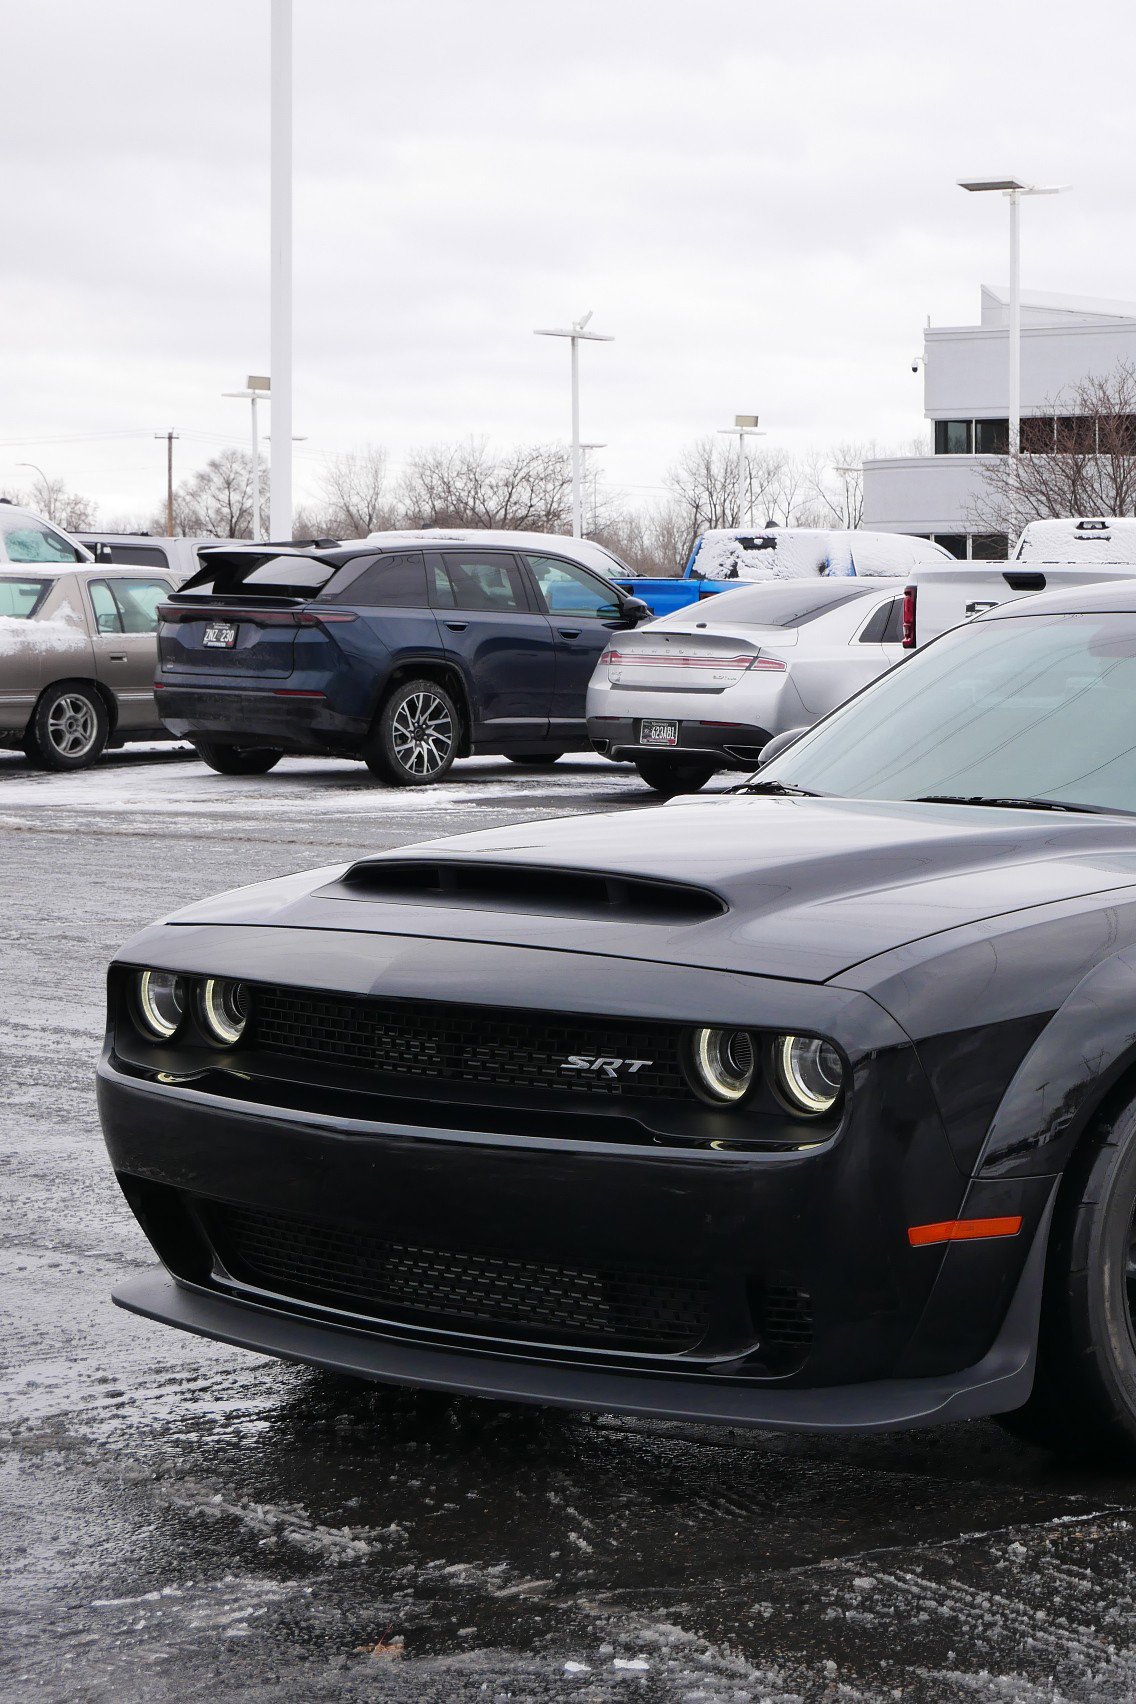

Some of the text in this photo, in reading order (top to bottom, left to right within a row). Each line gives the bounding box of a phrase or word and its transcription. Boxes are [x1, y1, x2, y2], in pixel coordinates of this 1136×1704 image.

[203, 629, 235, 642] ZNZ 230
[560, 1055, 654, 1078] SRT
